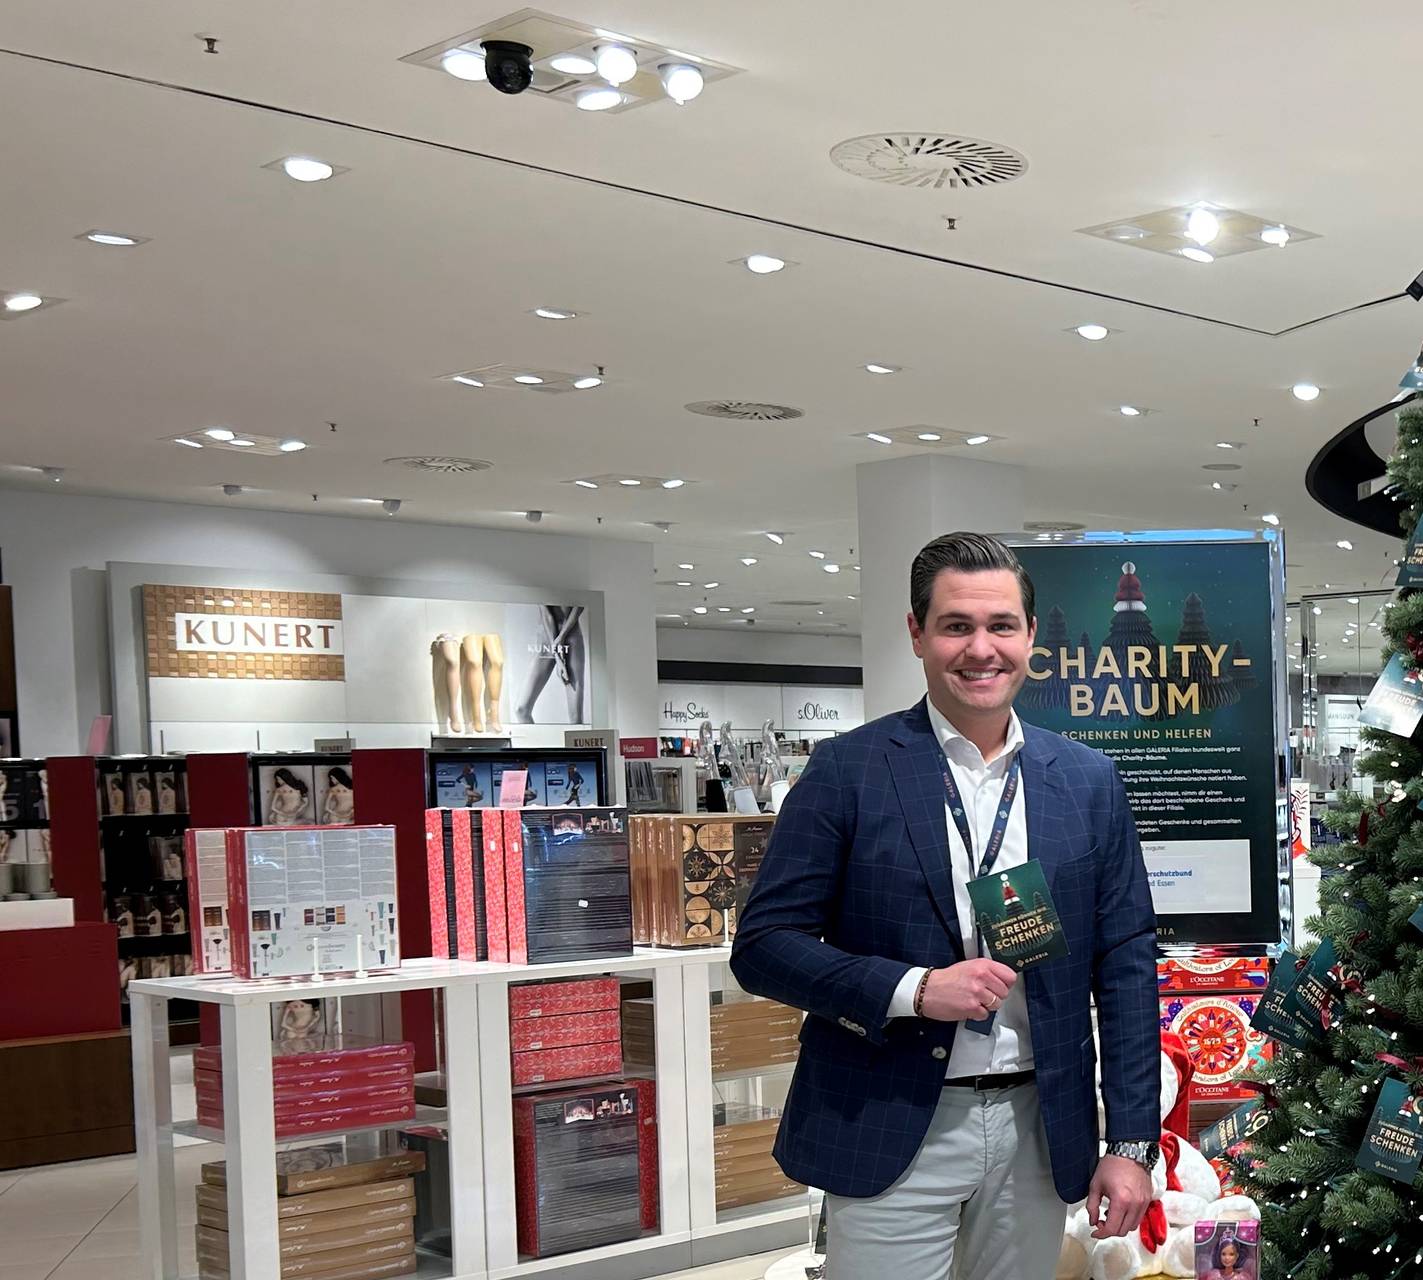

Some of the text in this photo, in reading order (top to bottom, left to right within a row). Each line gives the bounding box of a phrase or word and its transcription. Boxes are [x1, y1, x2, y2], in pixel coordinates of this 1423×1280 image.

[184, 619, 335, 649] KUNERT
[527, 643, 570, 654] KUNERT
[1025, 644, 1251, 681] CHARITY-
[1070, 682, 1201, 717] BAUM
[797, 702, 840, 721] s.Oliver
[573, 737, 604, 747] KUNERT
[1060, 728, 1212, 741] SCHENKEN UND HELFEN
[623, 745, 645, 753] Hudson
[1146, 746, 1170, 754] GALERIA
[1000, 914, 1044, 937] FREUDE
[994, 922, 1055, 951] SCHENKEN
[1025, 951, 1049, 964] GALERIA
[1306, 981, 1334, 1009] FREUE
[1369, 1134, 1419, 1159] SCHENKEN
[1379, 1127, 1416, 1147] FREUDE
